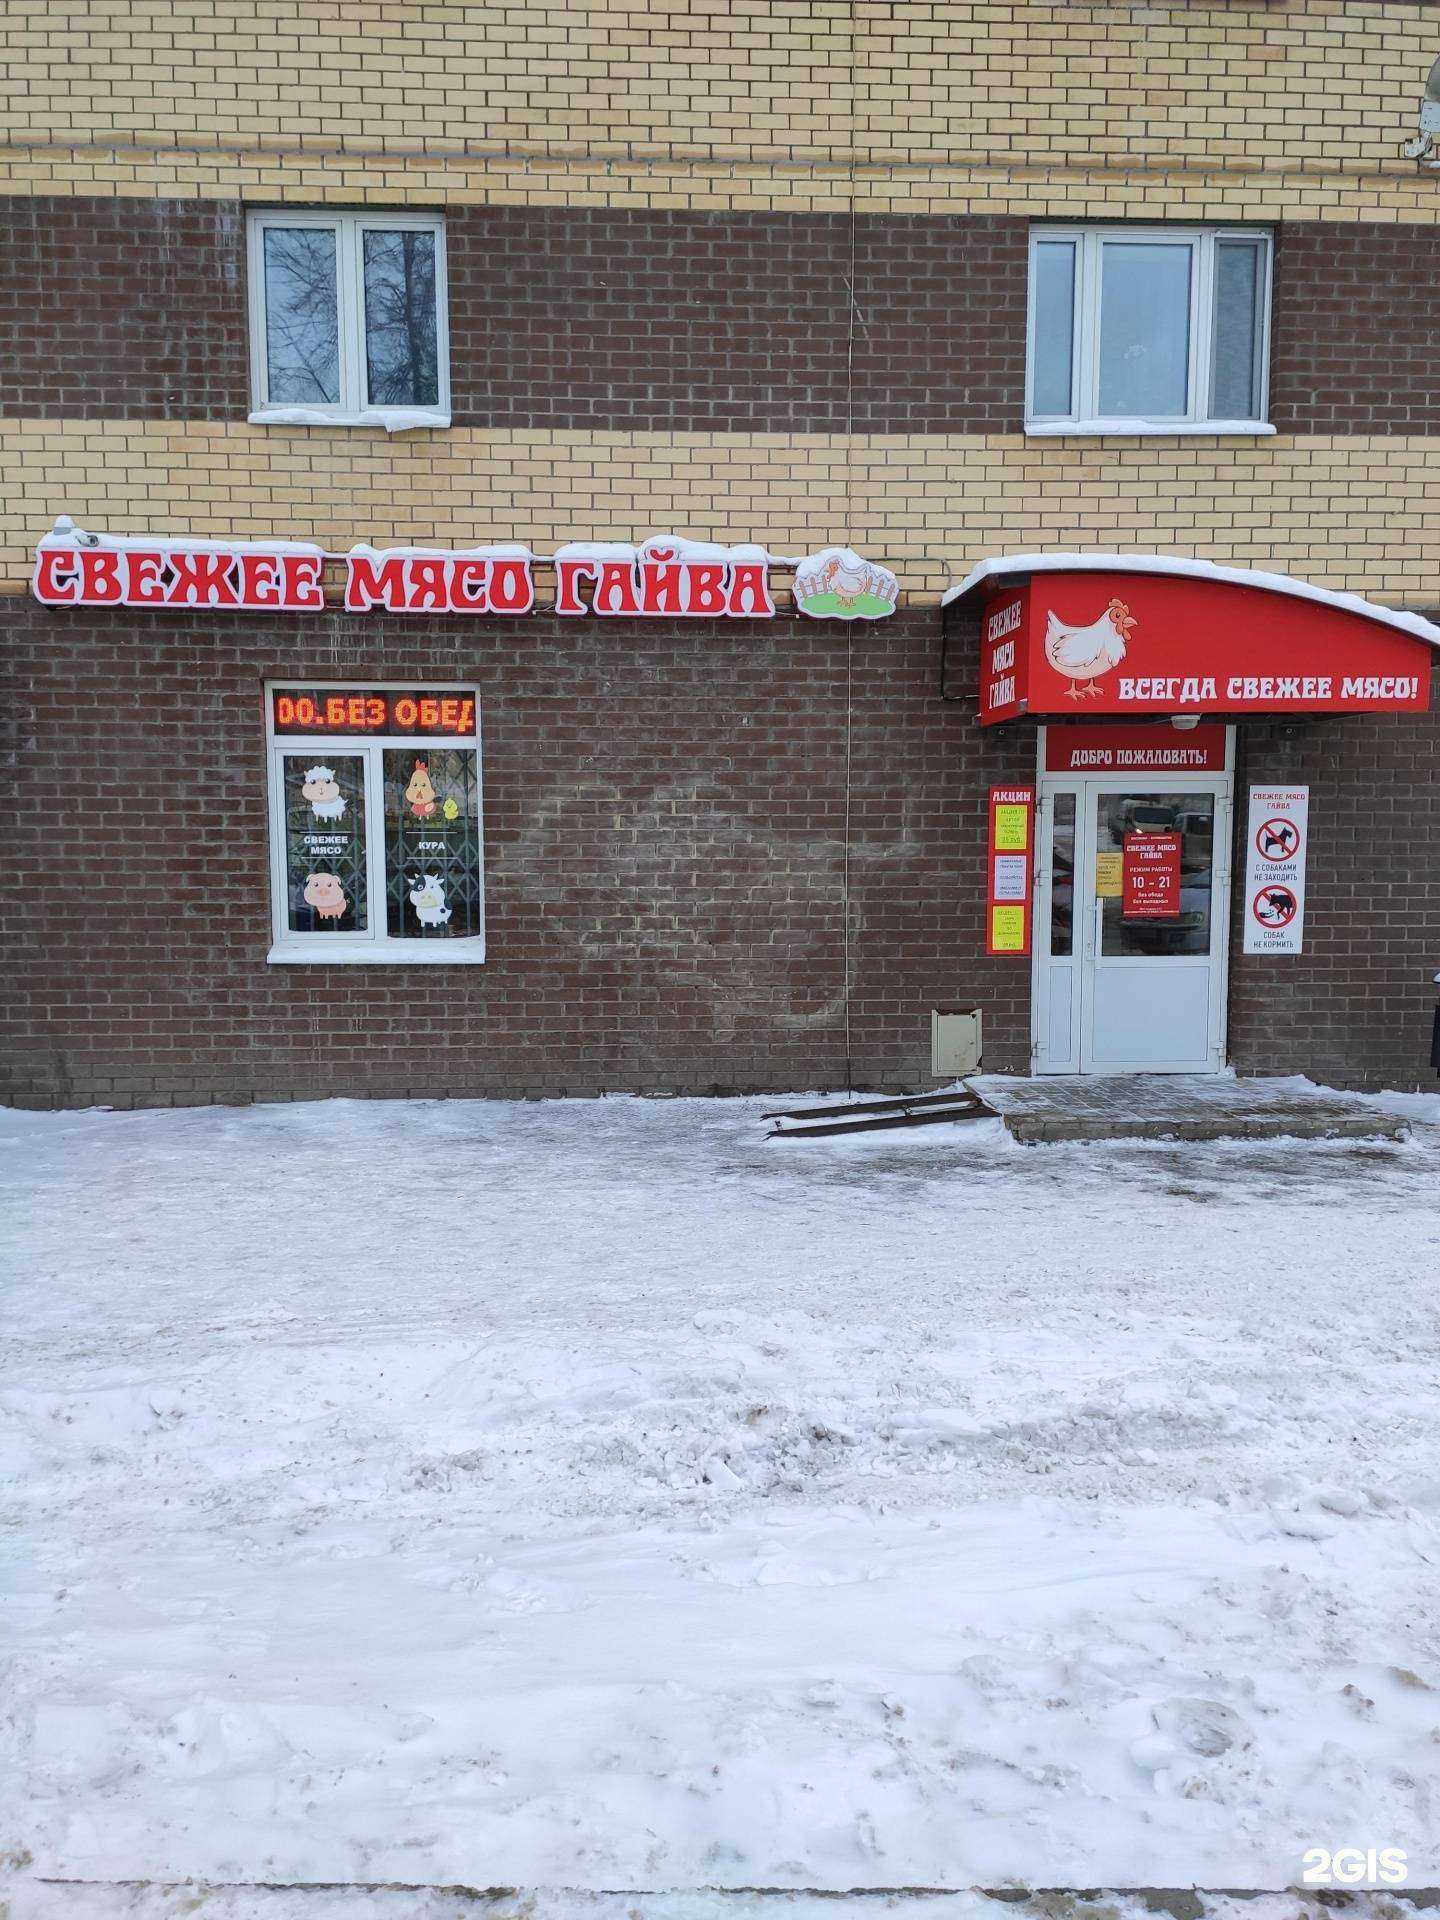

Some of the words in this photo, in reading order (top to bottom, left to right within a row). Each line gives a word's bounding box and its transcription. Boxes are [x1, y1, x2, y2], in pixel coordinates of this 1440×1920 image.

[36, 549, 323, 606] СВЕЖЕЕ
[350, 557, 534, 610] МЯСО
[556, 548, 771, 614] ГАЙВА
[988, 600, 1021, 642] СВЕЖЕЕ
[992, 640, 1015, 674] МЯСО
[989, 673, 1015, 709] ГАЙВА
[1118, 677, 1217, 703] ВСЕГДА
[1226, 677, 1331, 699] СВЕЖЕЕ
[1340, 677, 1419, 699] МЯСО!
[1070, 749, 1113, 767] ДОБРО
[1116, 749, 1208, 765] ПОЖАЛОВАТЬ!
[992, 791, 1031, 803] АКЦИИ
[1267, 801, 1290, 809] ГАЙВА
[303, 835, 349, 845] СВЕЖЕЕ
[418, 841, 446, 850] КУРА
[310, 846, 342, 855] МЯСО
[1262, 863, 1297, 871] СОБАКАМИ
[1132, 876, 1145, 889] 10
[1158, 876, 1170, 888] 21
[1254, 873, 1261, 881] НЕ
[1263, 873, 1298, 882] ЗАХОДИТЬ
[1263, 931, 1285, 939] СОБАК
[1253, 941, 1261, 949] НЕ
[1263, 940, 1294, 949] КОРМИТЬ
